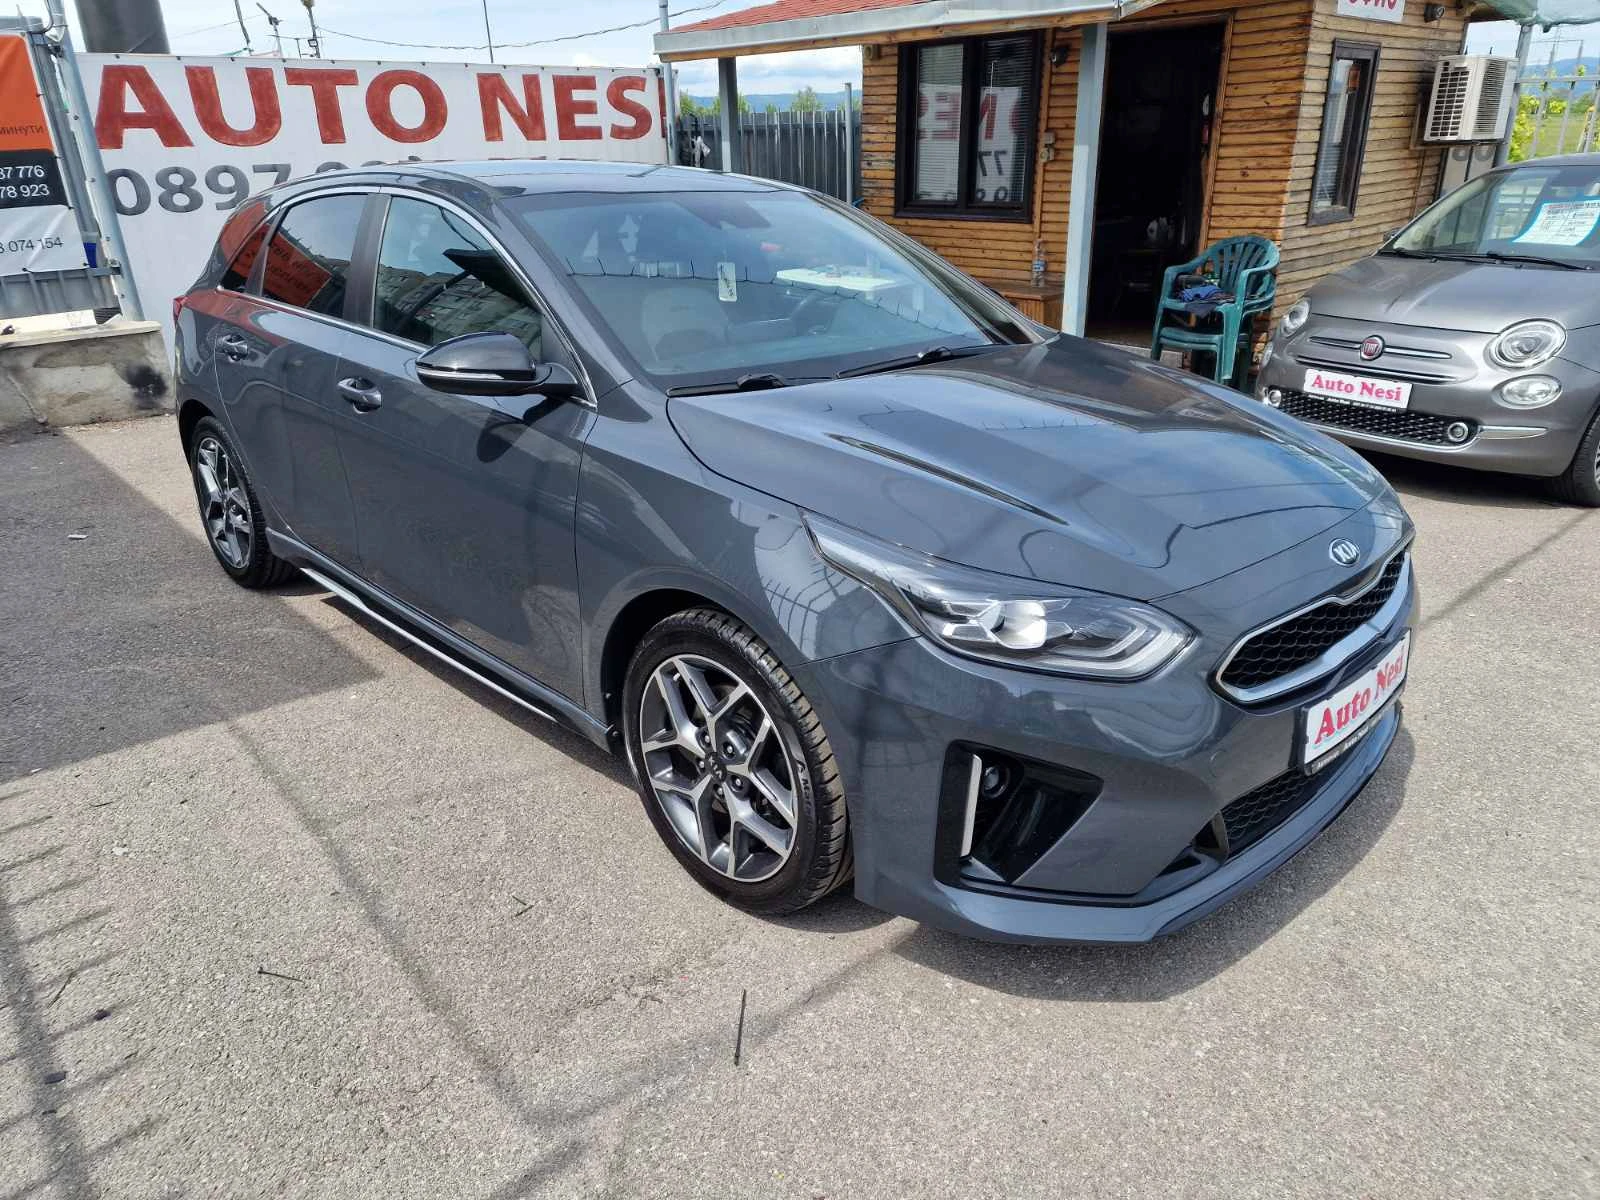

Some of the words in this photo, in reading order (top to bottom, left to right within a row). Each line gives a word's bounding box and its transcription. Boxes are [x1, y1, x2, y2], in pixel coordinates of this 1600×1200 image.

[95, 64, 449, 148] AUTO
[15, 164, 45, 178] 776
[20, 183, 50, 197] 923
[8, 239, 35, 252] 074
[1311, 374, 1355, 394] Auto
[1359, 381, 1403, 401] Nesi
[1314, 687, 1372, 745] Auto
[1374, 643, 1406, 701] Nesi
